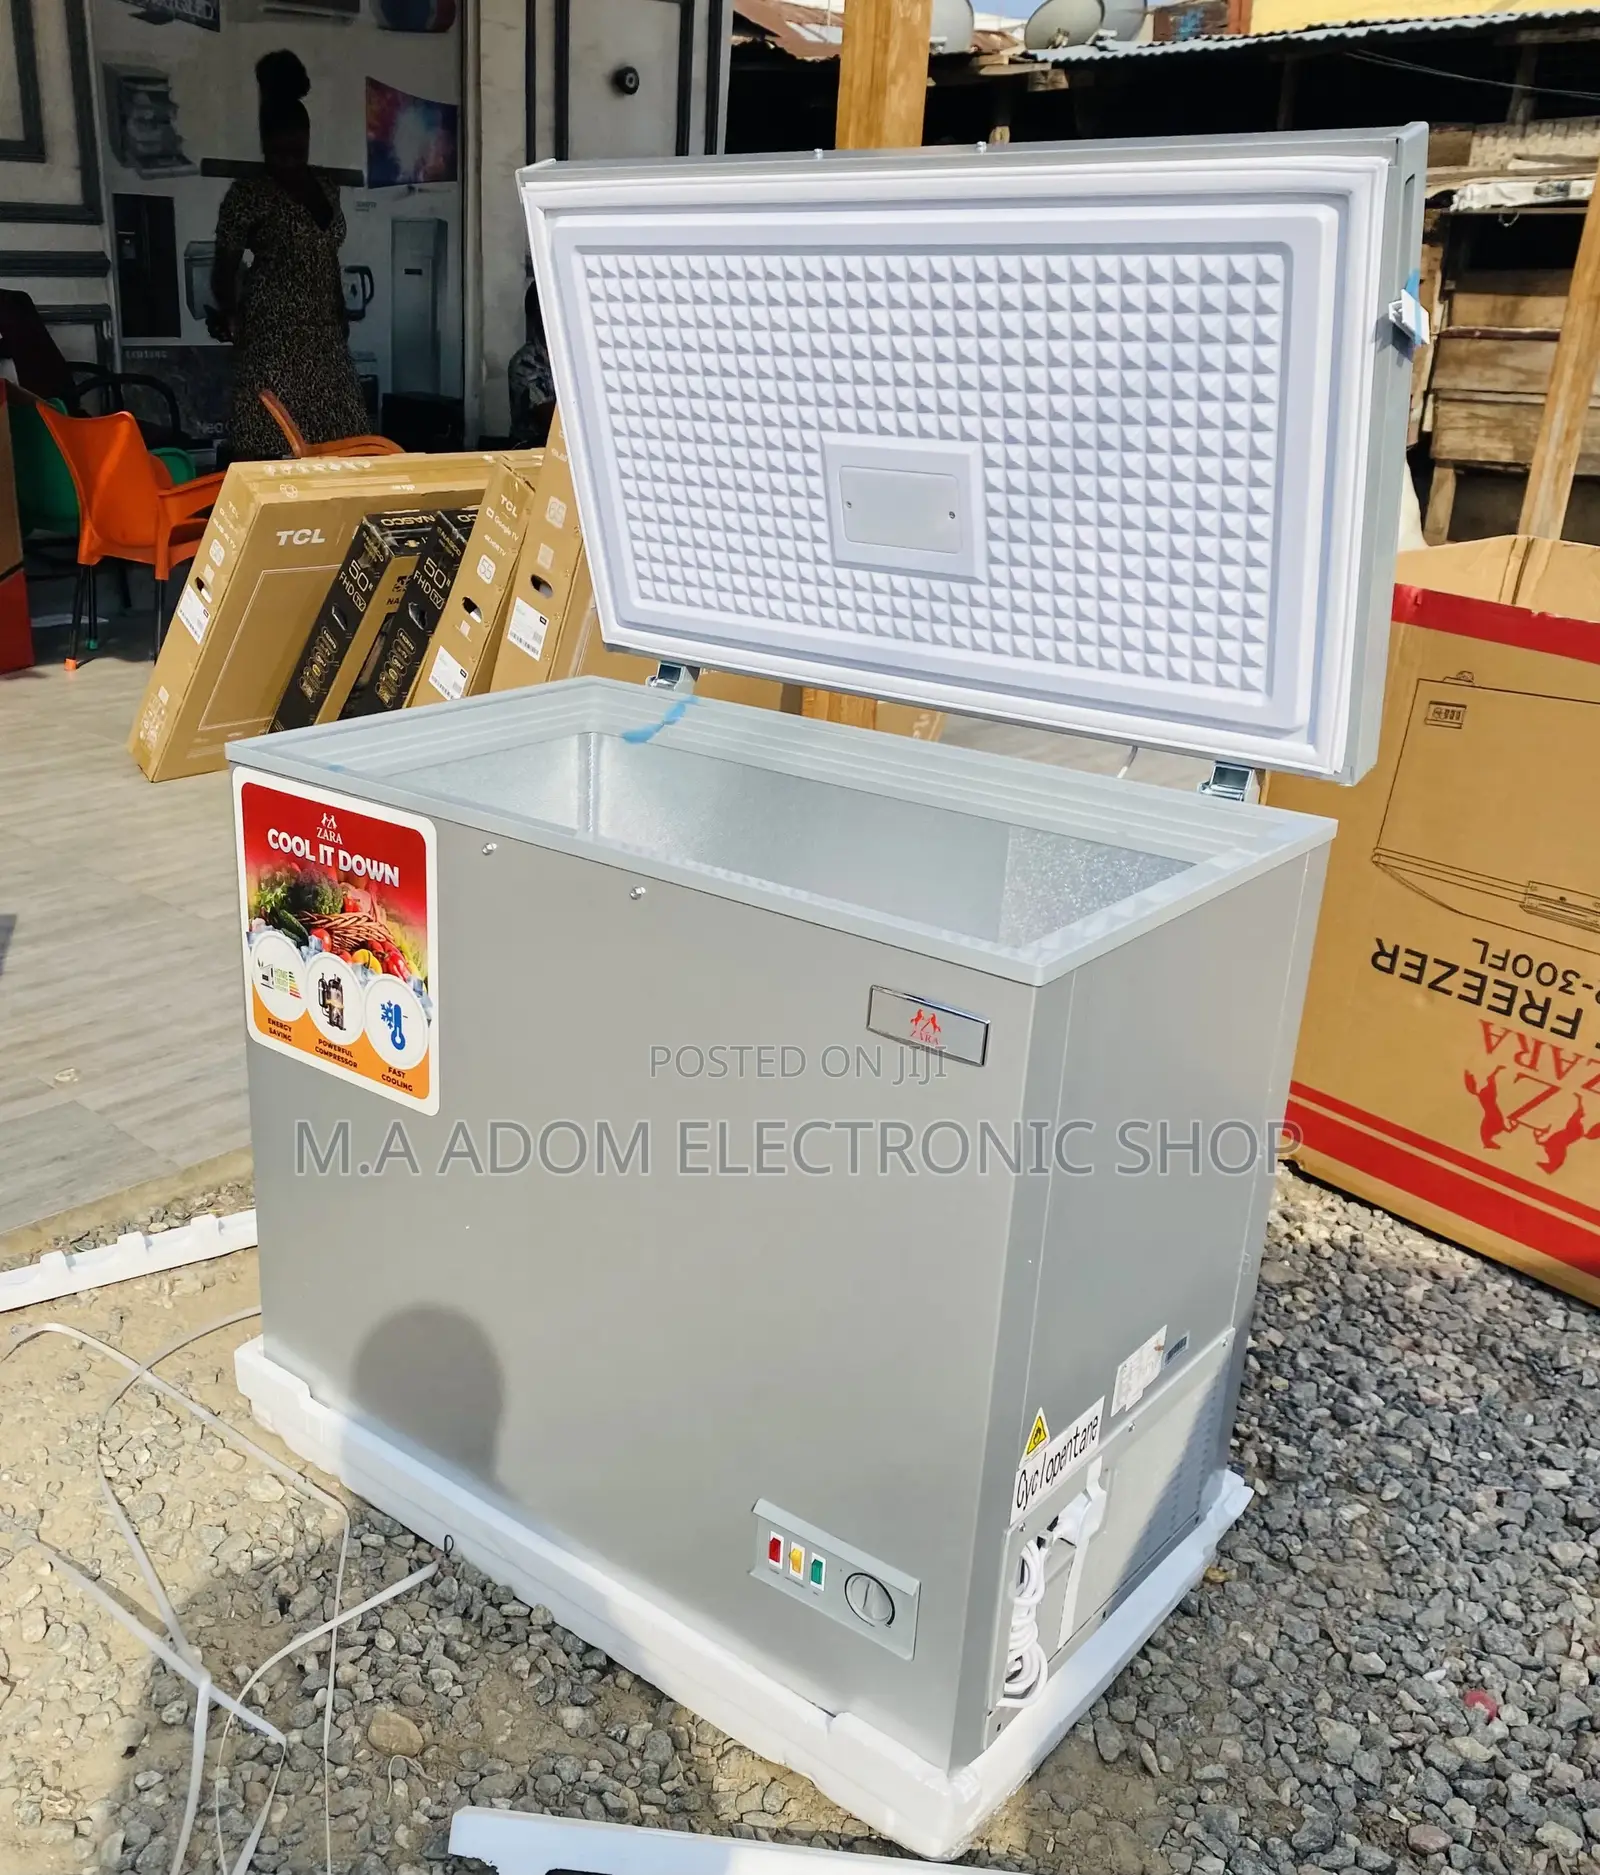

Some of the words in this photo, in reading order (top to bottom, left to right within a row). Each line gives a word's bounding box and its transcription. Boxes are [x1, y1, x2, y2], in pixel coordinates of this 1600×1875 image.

[501, 494, 518, 518] TCL
[380, 515, 436, 527] NASCO
[276, 528, 327, 547] TCL
[339, 571, 355, 596] FHD
[353, 591, 367, 612] TV
[413, 570, 432, 595] FHD
[430, 589, 445, 610] TV
[316, 826, 343, 845] ZARA
[267, 828, 315, 862] COOL
[319, 846, 335, 868] IT
[338, 849, 400, 888] DOWN
[1371, 937, 1583, 1040] FREEZER
[267, 1017, 293, 1034] ENERGY
[268, 1027, 293, 1042] SAVING
[314, 1045, 358, 1069] COMPRESSOR
[318, 1038, 354, 1059] POWERFUL
[388, 1065, 406, 1079] FAST
[381, 1073, 414, 1093] COOLING
